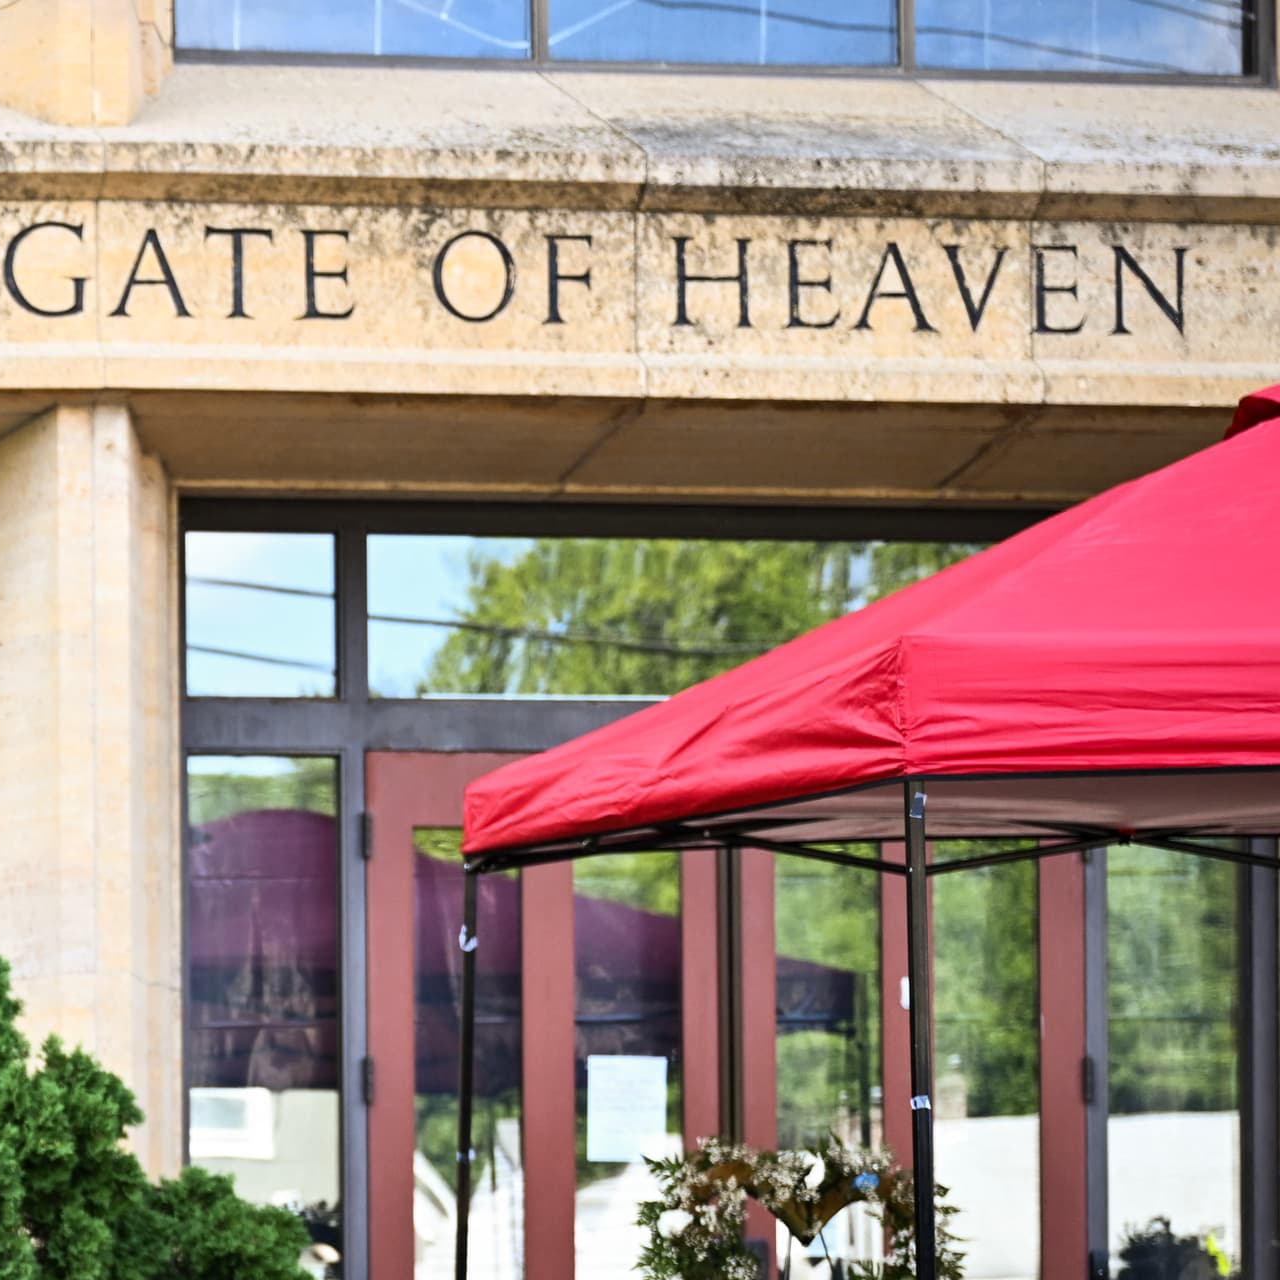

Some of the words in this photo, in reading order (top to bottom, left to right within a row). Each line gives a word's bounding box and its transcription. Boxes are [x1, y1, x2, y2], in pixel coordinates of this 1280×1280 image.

[3, 220, 356, 320] GATE
[432, 229, 594, 325] OF
[669, 234, 1189, 340] HEAVEN
